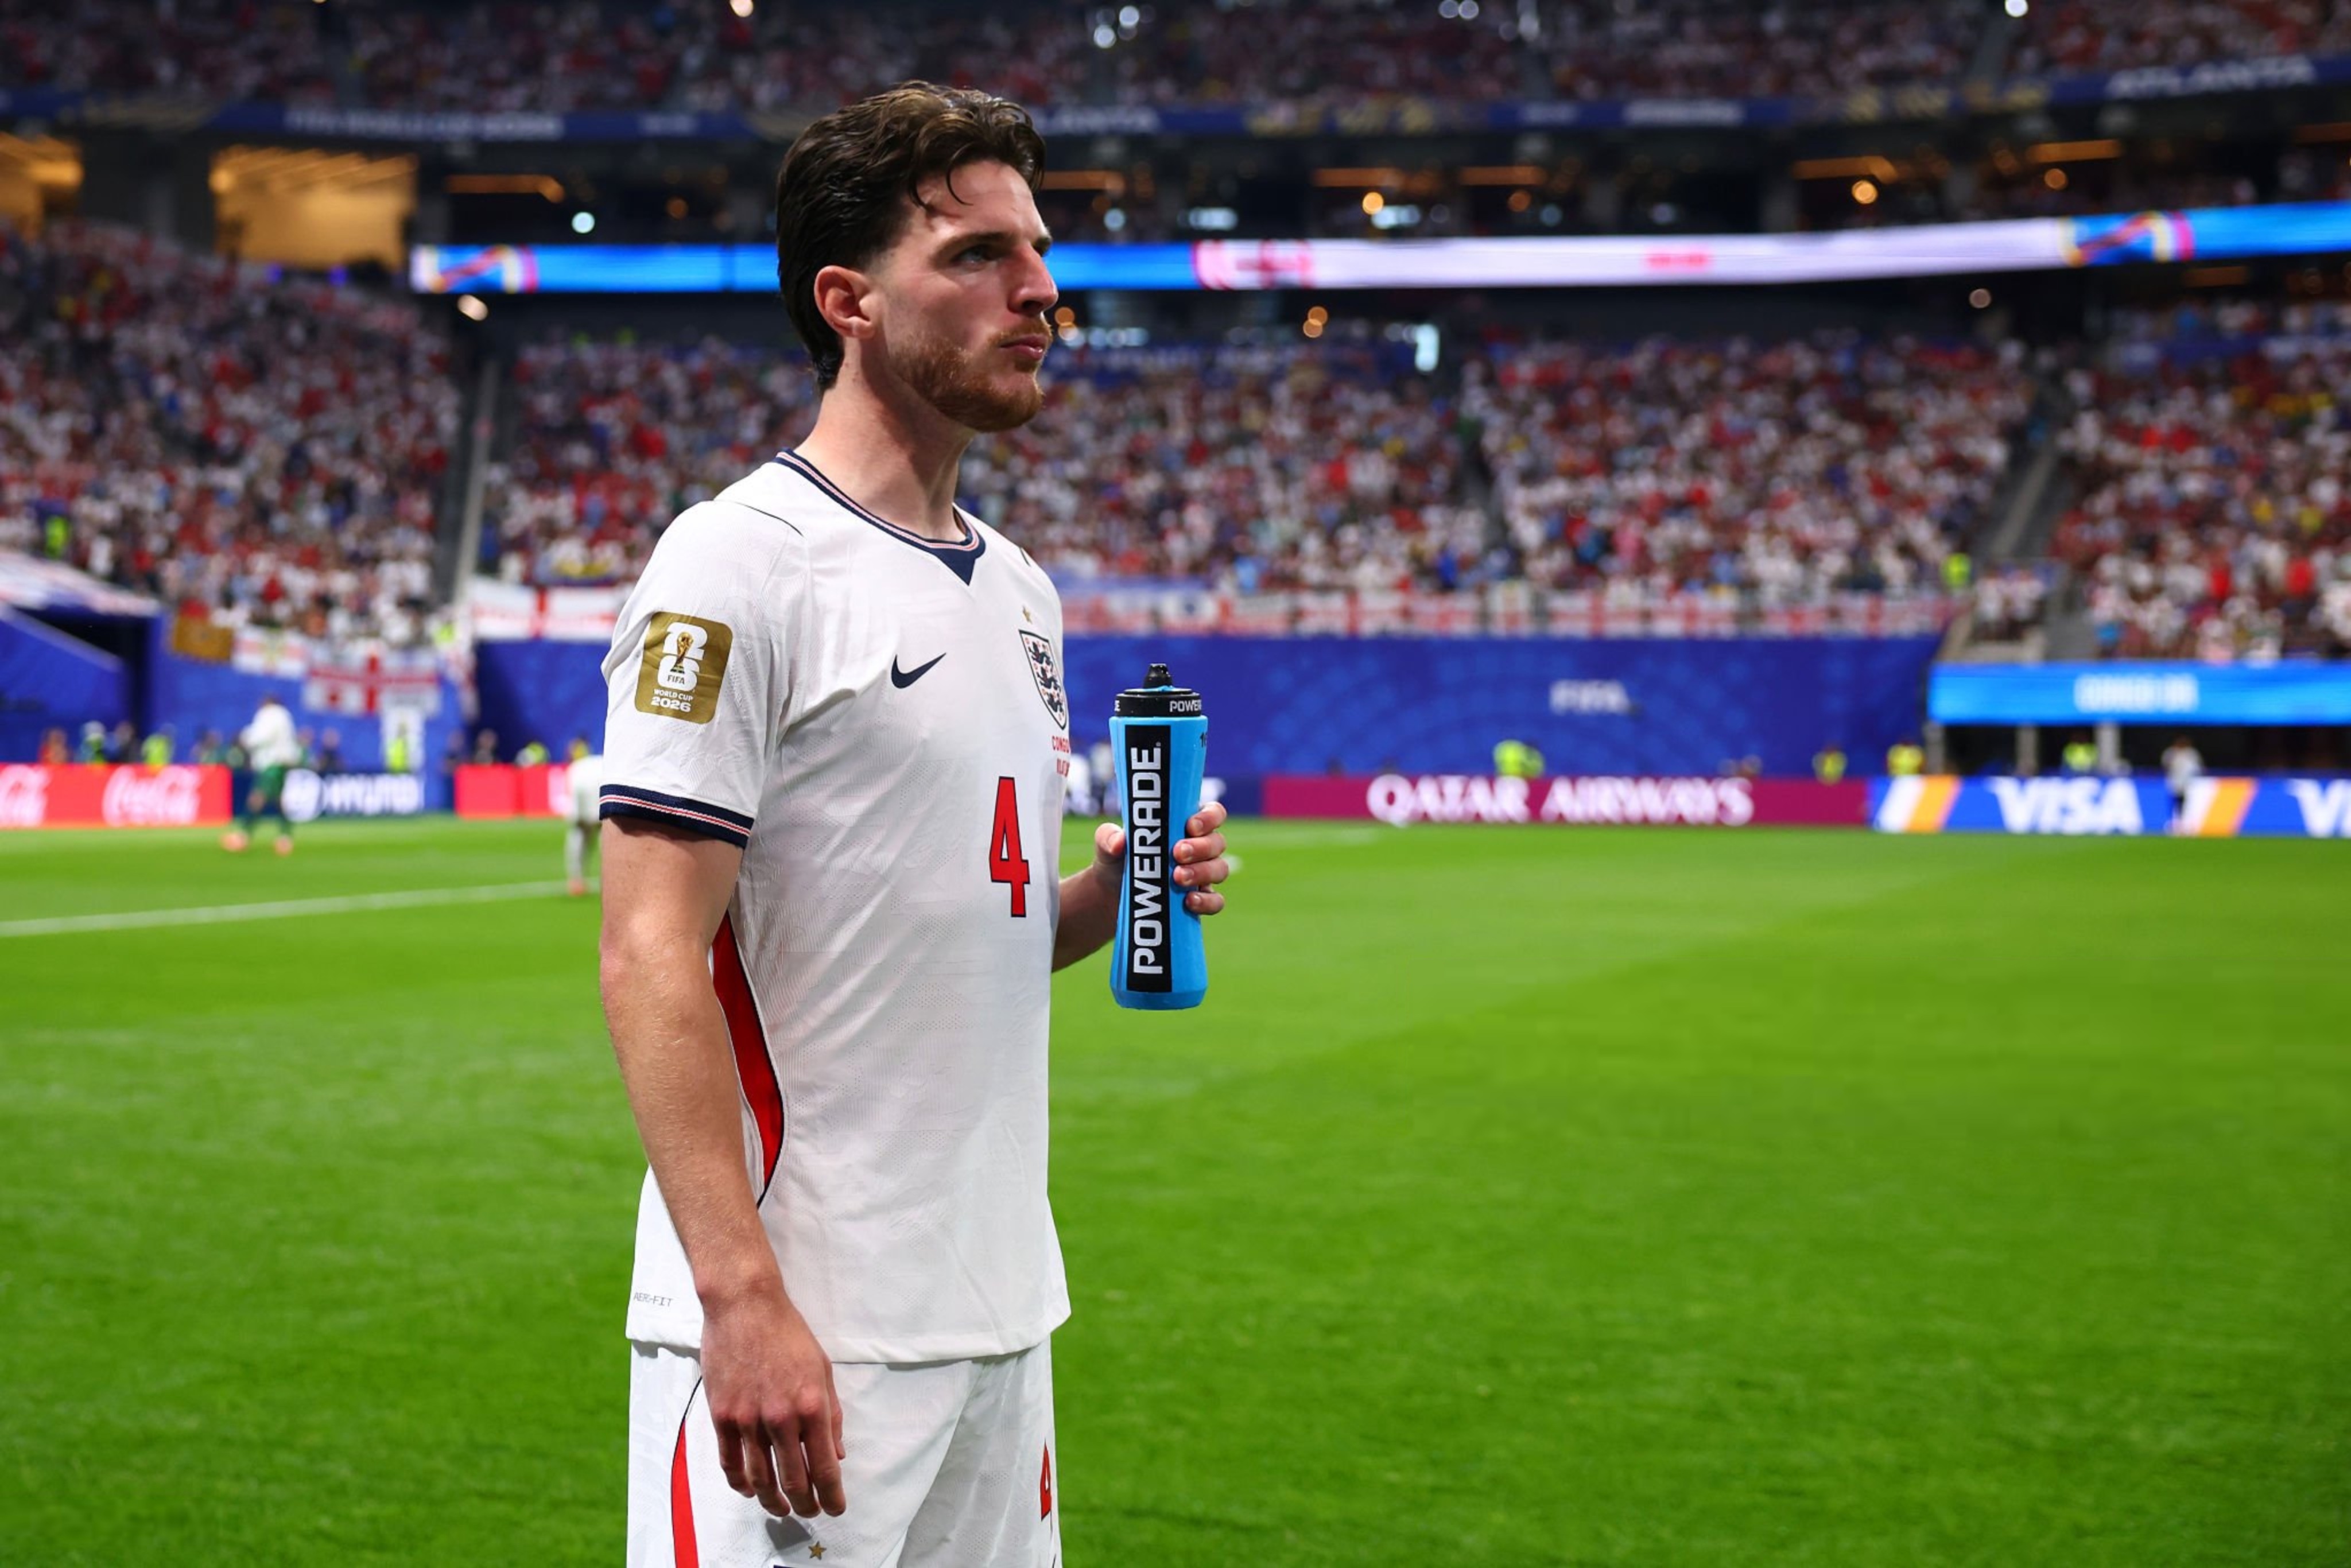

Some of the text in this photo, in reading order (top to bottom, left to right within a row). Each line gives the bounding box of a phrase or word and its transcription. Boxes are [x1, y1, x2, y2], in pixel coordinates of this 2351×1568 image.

[650, 696, 692, 713] 2026
[654, 689, 694, 703] WORLD CUP
[667, 674, 686, 685] FIFA
[1367, 775, 1753, 826] QATAR AIRWAYS
[1984, 777, 2144, 834] VISA
[989, 776, 1030, 918] 4
[1131, 747, 1162, 975] POWERADE
